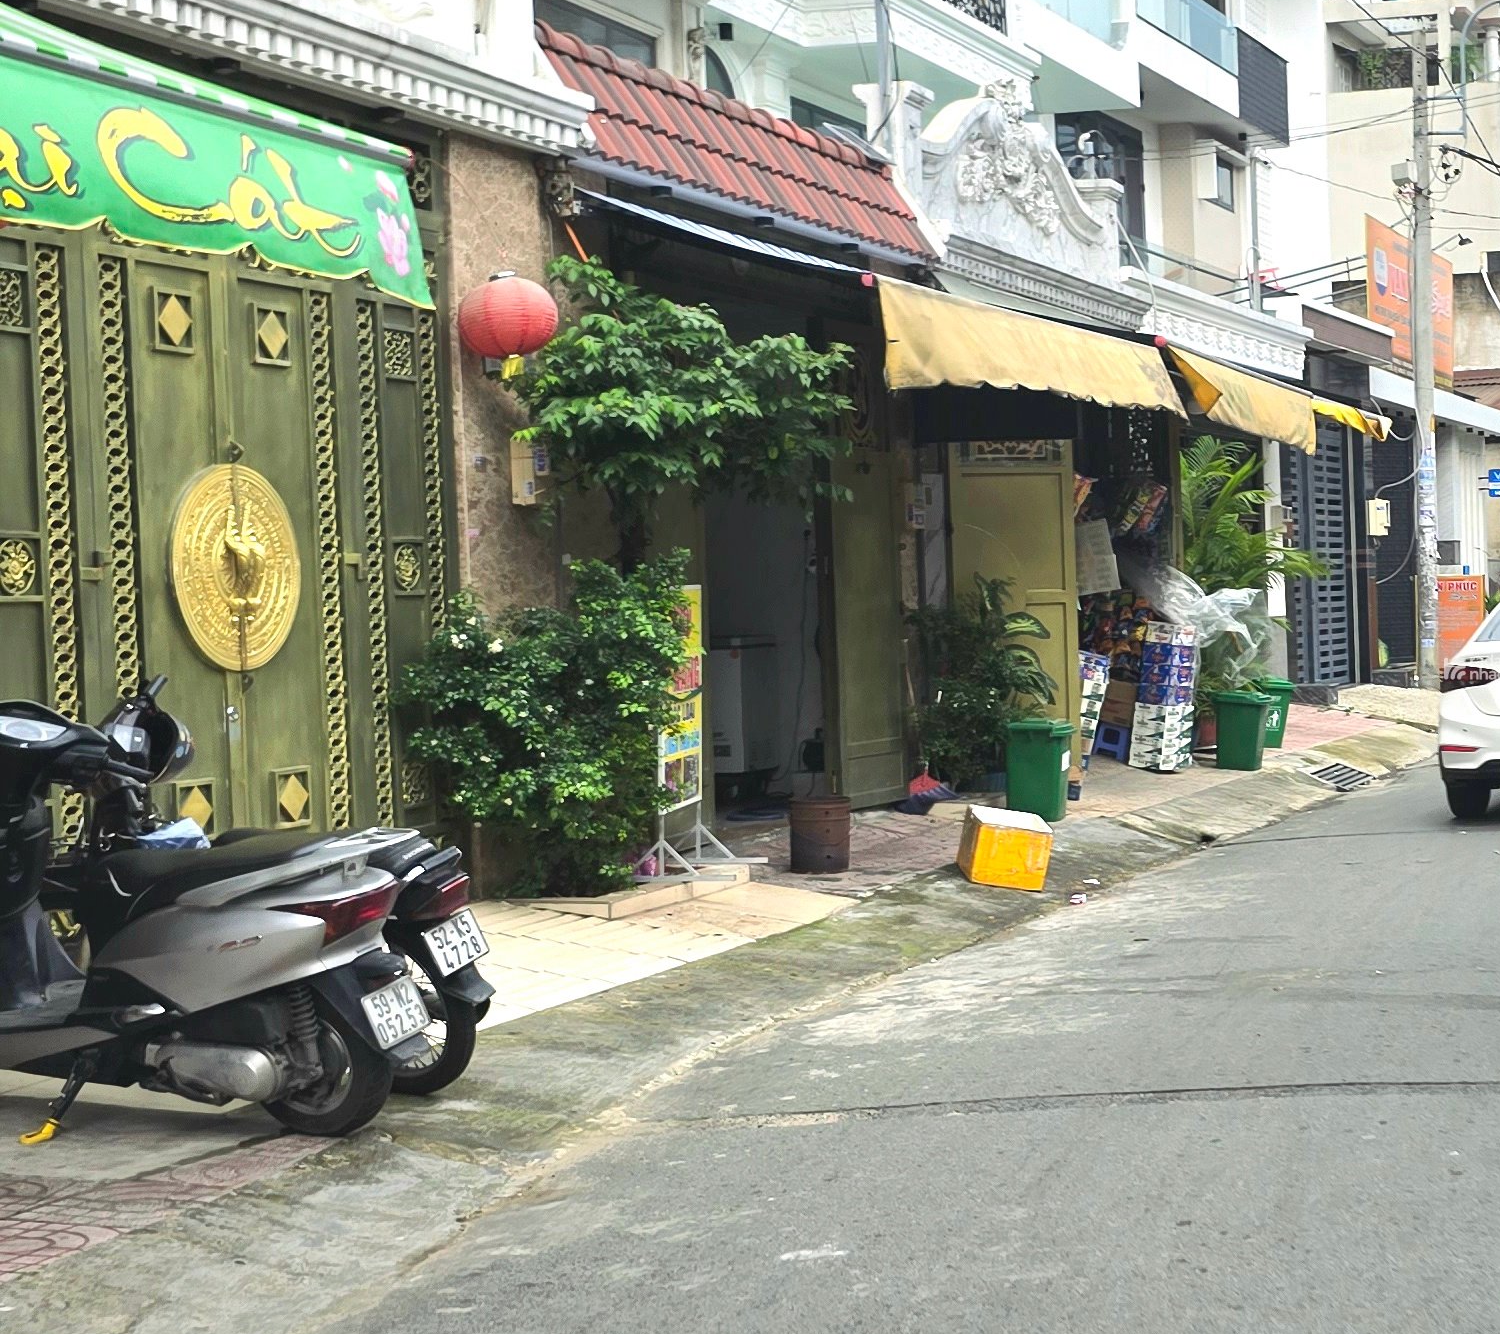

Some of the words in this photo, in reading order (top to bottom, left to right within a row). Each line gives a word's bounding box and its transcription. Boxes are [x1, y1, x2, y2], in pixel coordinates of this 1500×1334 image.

[97, 105, 361, 257] Cát
[431, 914, 472, 949] 52-K5
[443, 935, 482, 969] 4728
[370, 983, 414, 1018] 59-N2
[377, 1003, 426, 1044] 052.53
